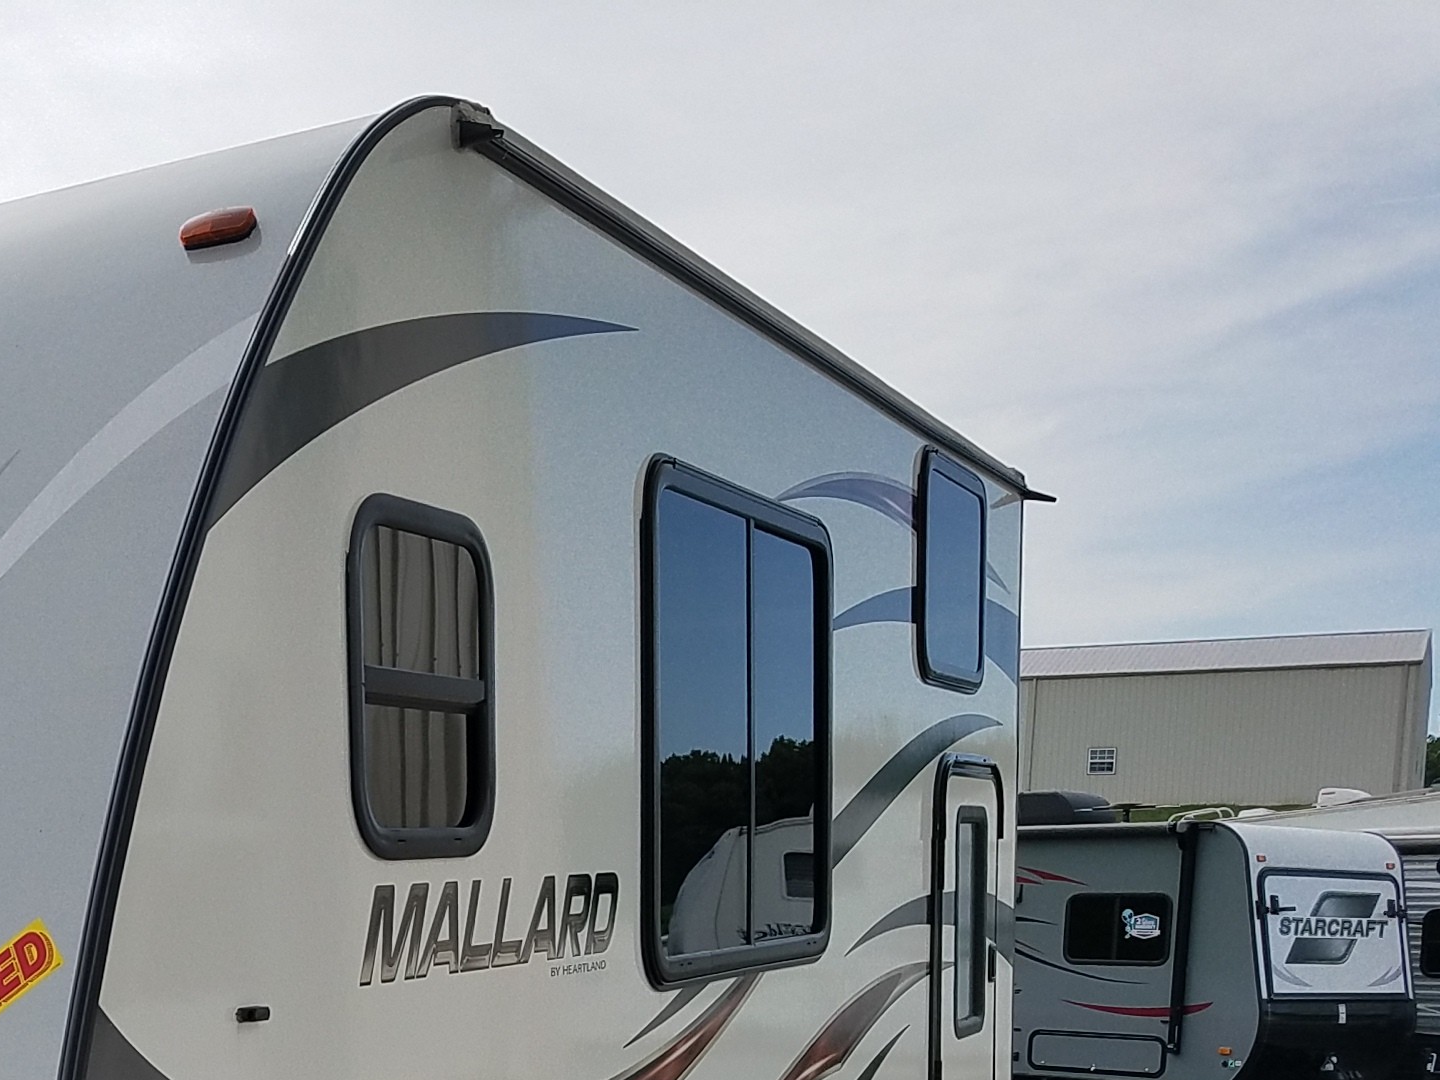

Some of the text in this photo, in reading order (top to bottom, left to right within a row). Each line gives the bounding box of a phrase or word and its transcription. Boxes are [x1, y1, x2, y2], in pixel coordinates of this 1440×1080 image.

[359, 872, 619, 987] MALLARD
[1279, 916, 1389, 938] STARCRAFT
[550, 959, 607, 977] BY HEARTLAND
